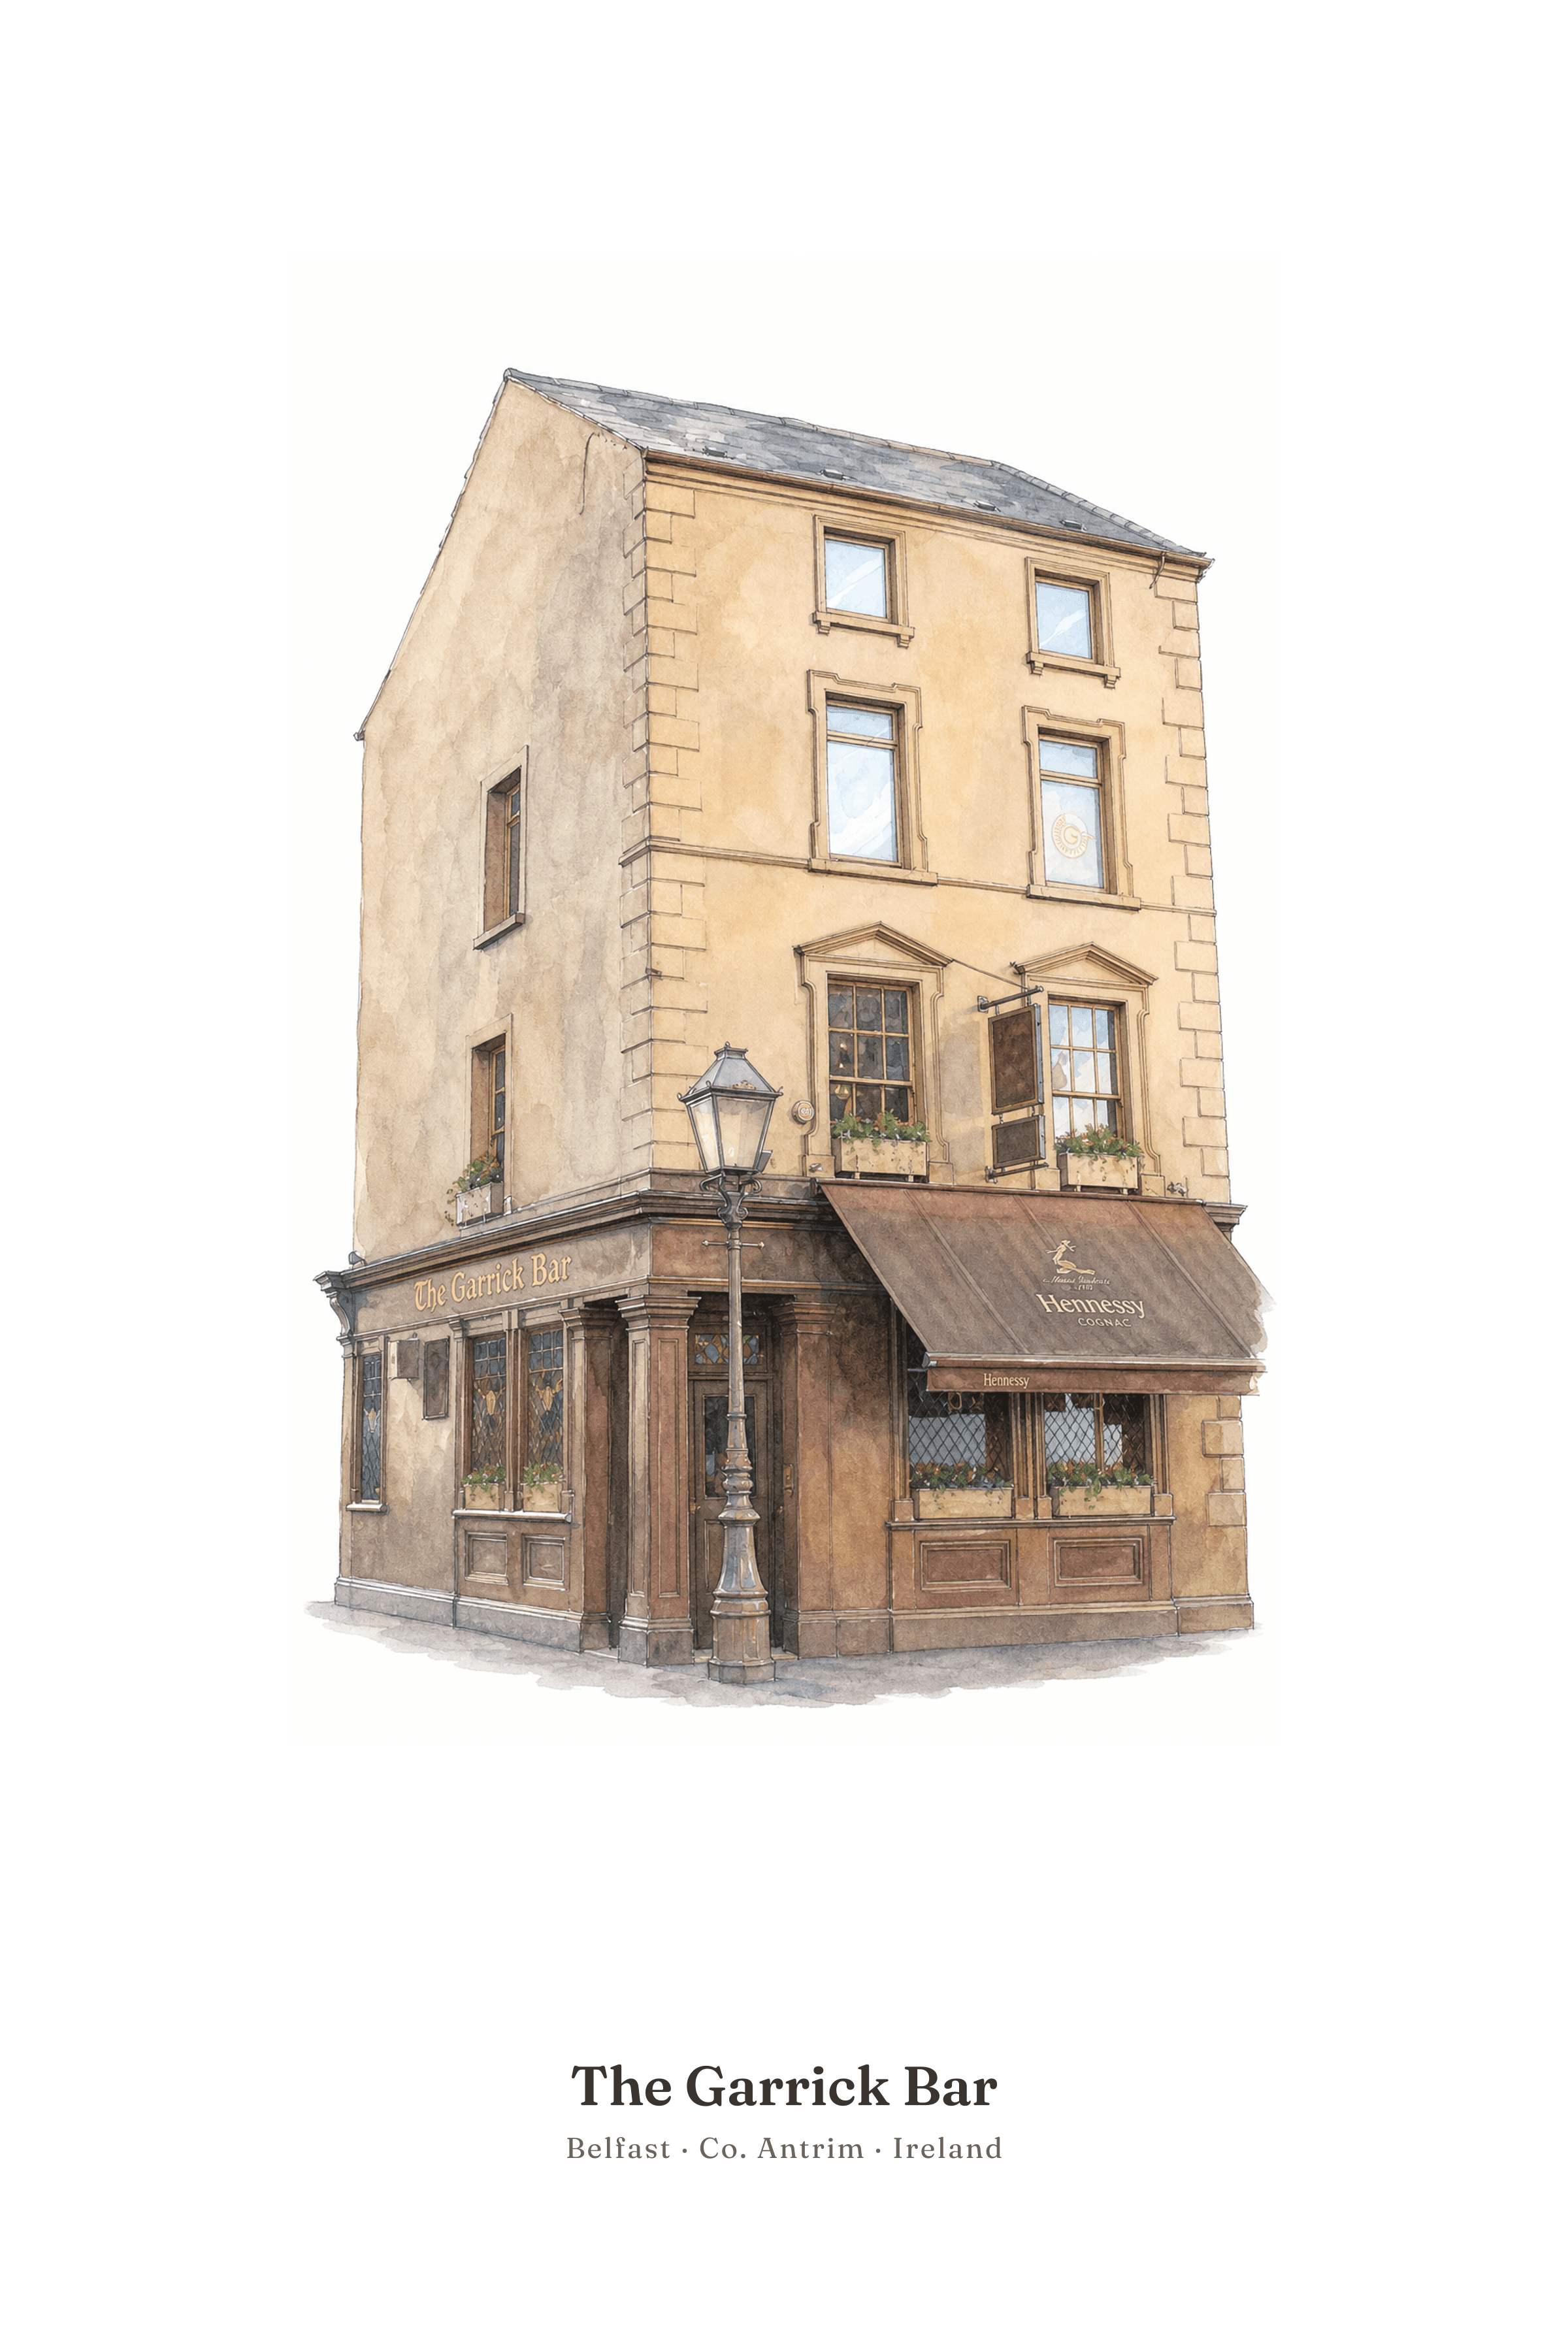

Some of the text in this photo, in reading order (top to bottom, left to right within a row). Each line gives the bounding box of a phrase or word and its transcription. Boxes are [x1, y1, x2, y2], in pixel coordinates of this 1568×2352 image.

[414, 1252, 572, 1313] The Garrick Bar
[1036, 1294, 1145, 1319] Hennessy
[1078, 1317, 1132, 1328] COGNAC
[983, 1373, 1030, 1390] Hennessy
